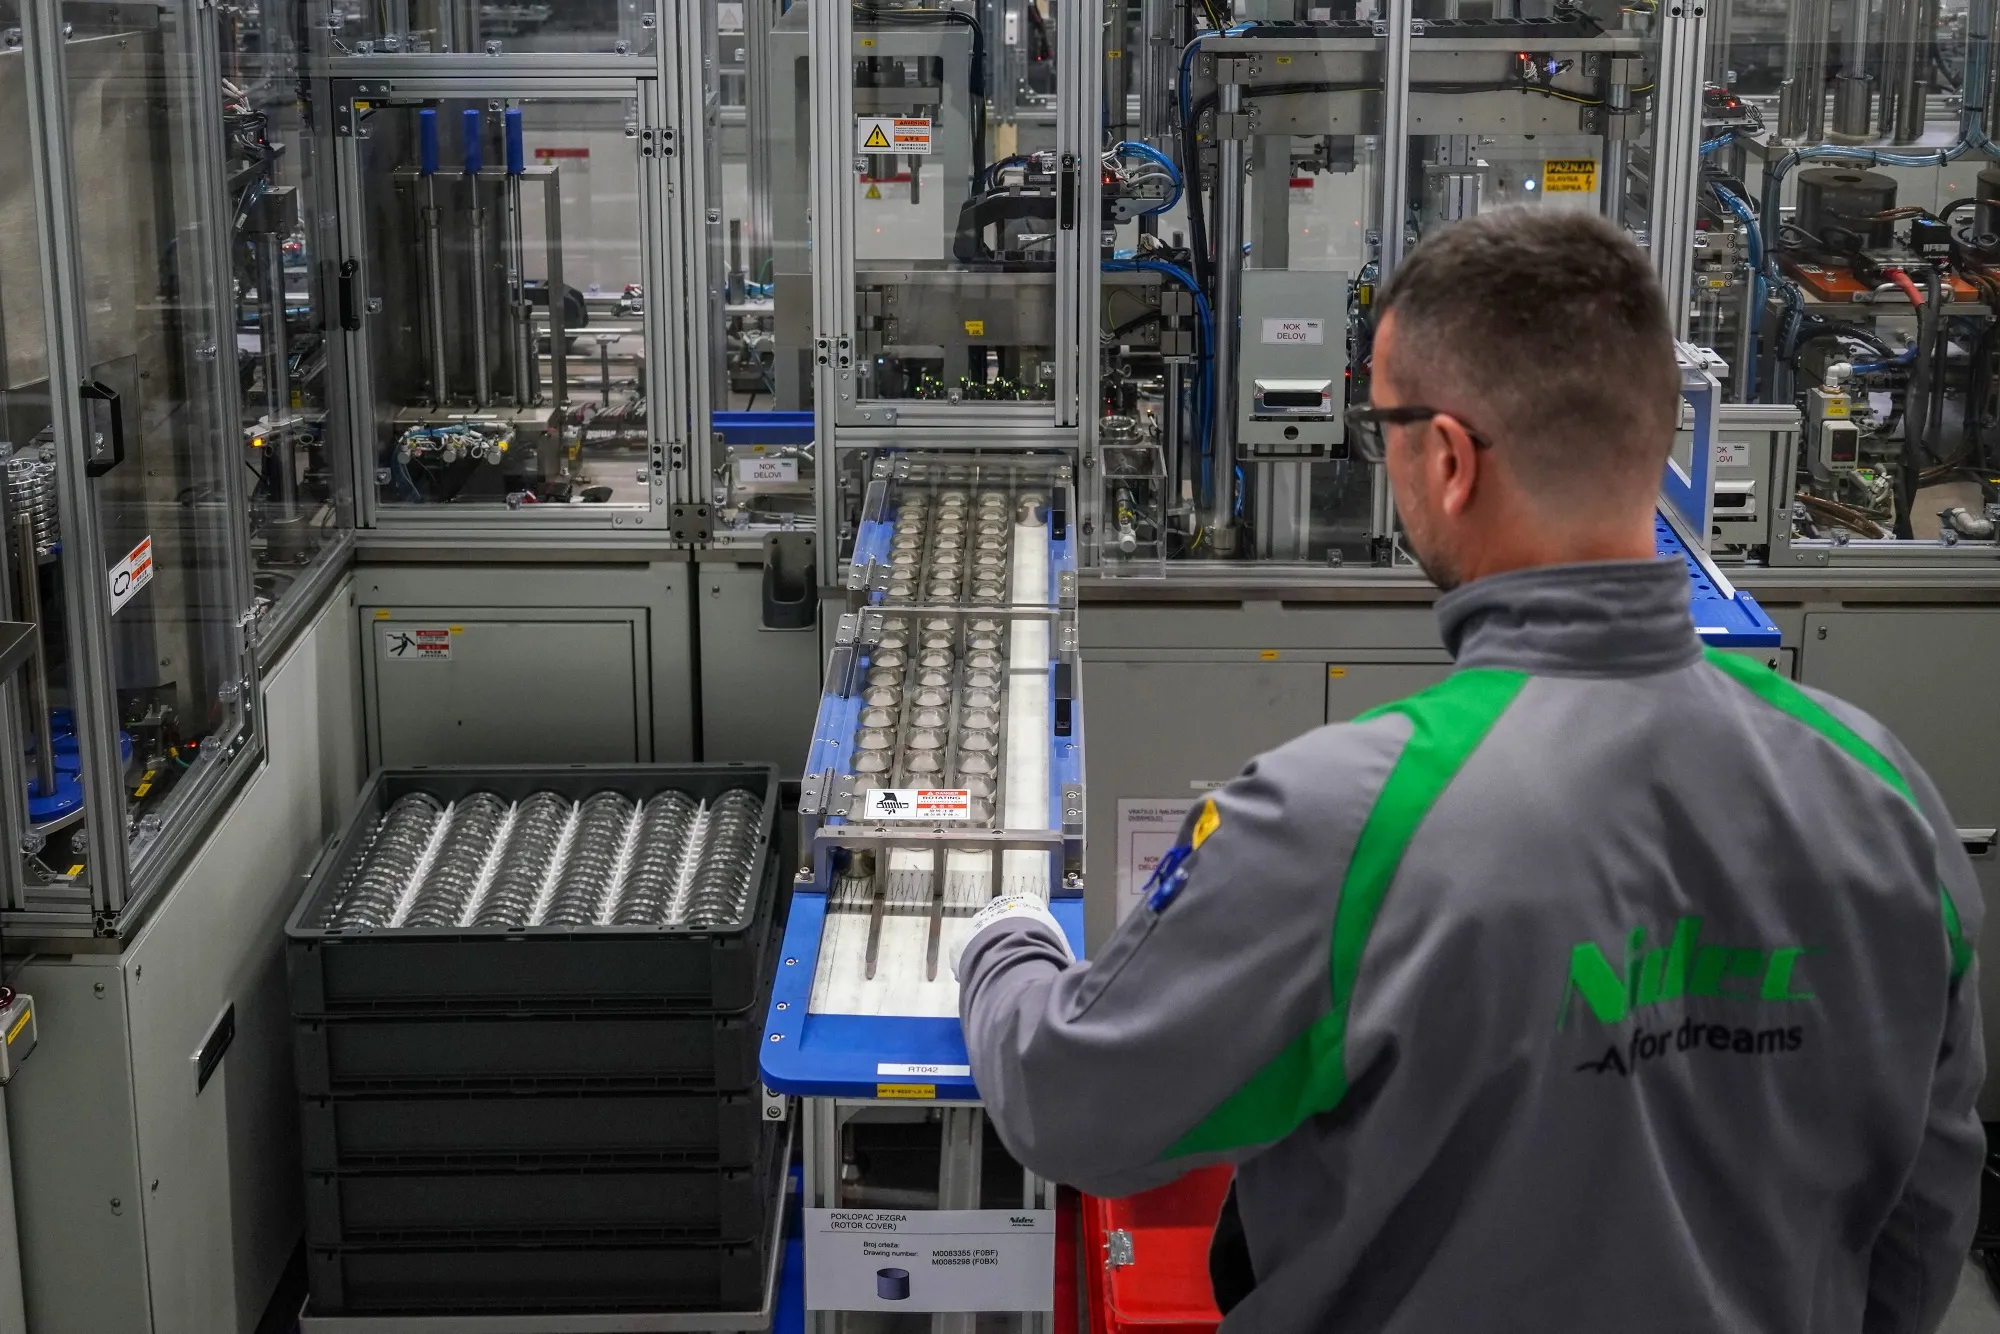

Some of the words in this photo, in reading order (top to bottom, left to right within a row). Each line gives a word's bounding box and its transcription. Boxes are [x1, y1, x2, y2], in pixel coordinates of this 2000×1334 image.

[1548, 160, 1593, 172] PAŽNJA
[1276, 332, 1306, 340] DELOVI
[1558, 915, 1829, 1034] Nidec
[1629, 1027, 1673, 1074] for
[1676, 1016, 1804, 1056] dreams
[830, 1213, 874, 1221] POKLOPAC
[875, 1214, 907, 1222] JEZGRA
[830, 1221, 864, 1229] (ROTOR
[865, 1222, 897, 1231] COVER)
[863, 1249, 890, 1257] Drawing
